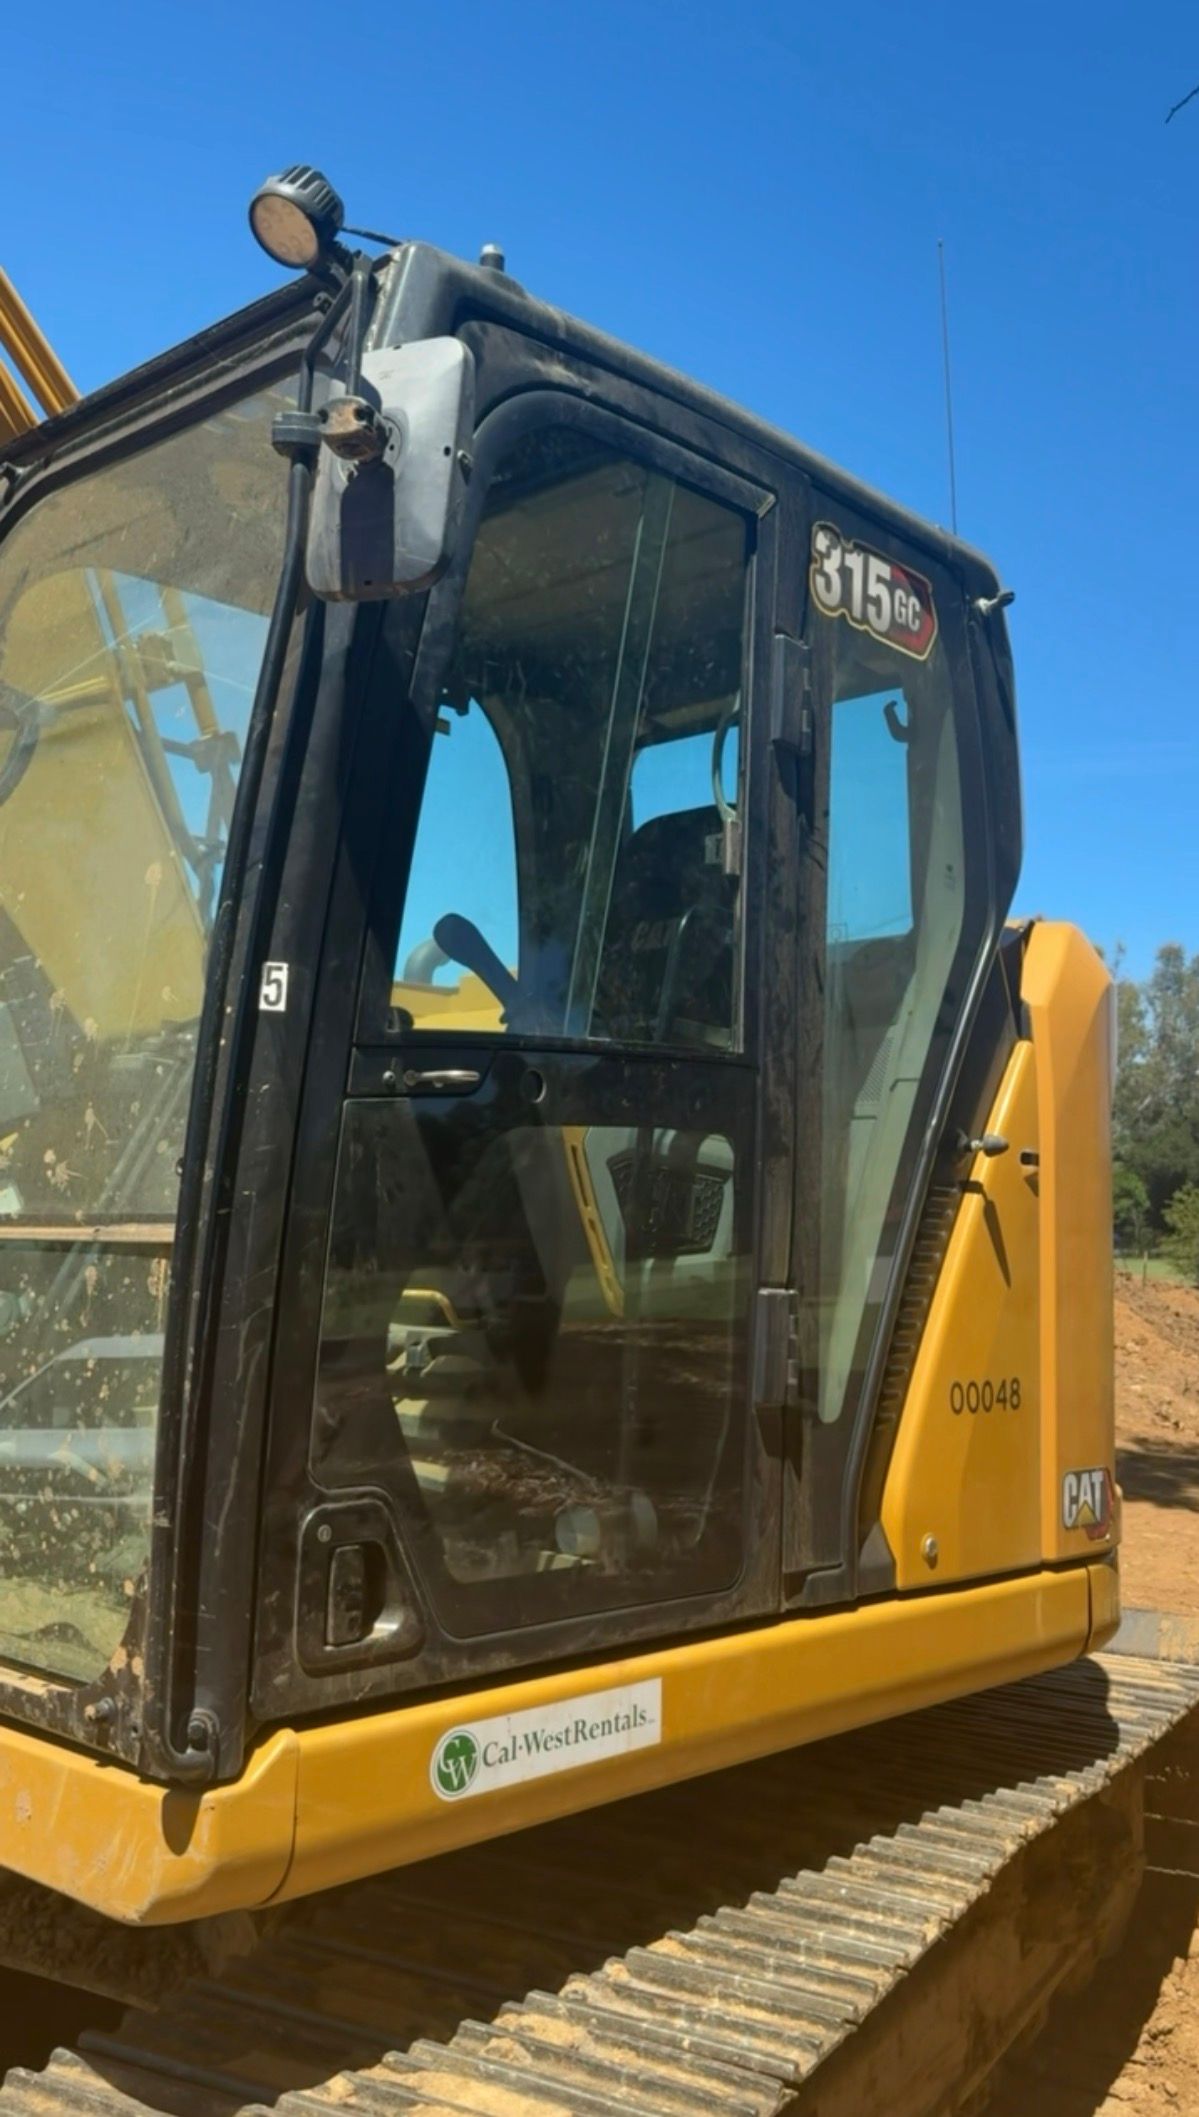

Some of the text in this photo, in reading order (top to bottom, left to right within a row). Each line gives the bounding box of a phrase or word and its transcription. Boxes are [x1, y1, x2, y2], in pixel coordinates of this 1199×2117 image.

[815, 529, 921, 633] 315 GC
[263, 965, 283, 1007] 5
[950, 1377, 1021, 1415] 00048
[1063, 1471, 1104, 1528] CAT
